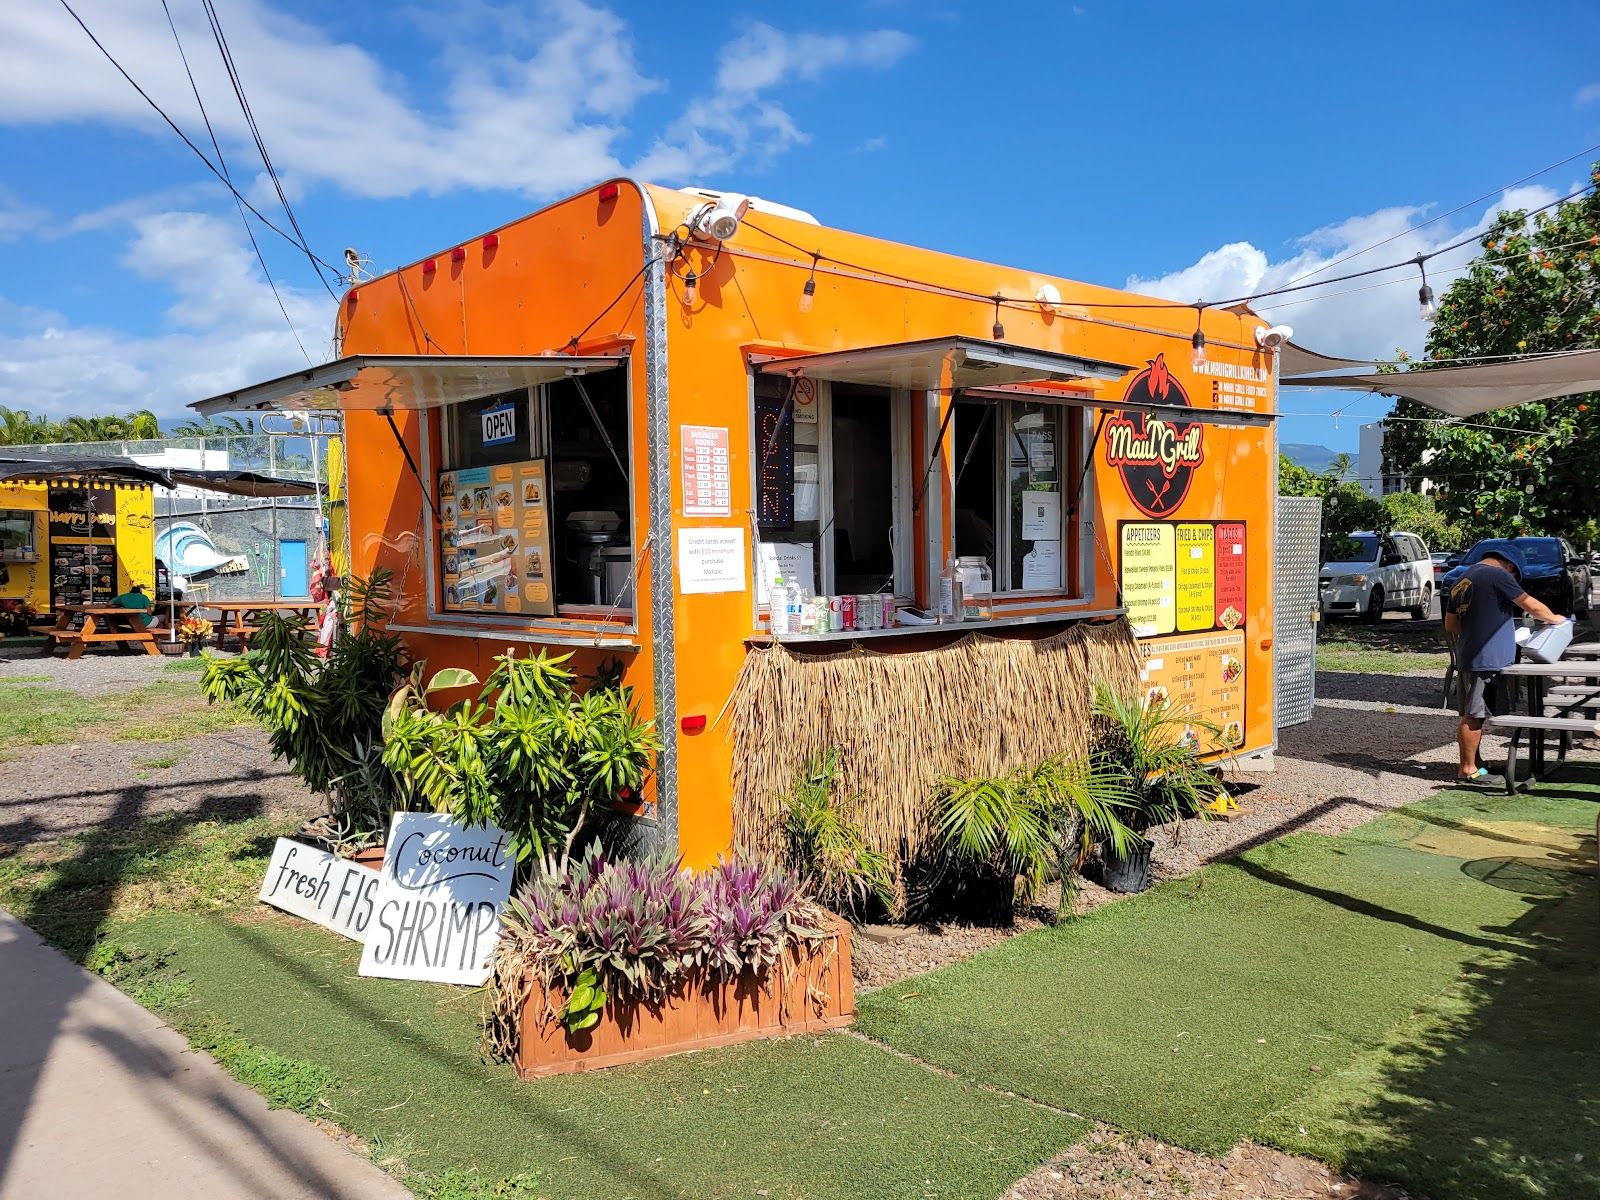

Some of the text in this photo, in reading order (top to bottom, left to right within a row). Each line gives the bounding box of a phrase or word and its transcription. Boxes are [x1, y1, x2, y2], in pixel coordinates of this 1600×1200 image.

[486, 412, 513, 440] OPEN
[1031, 431, 1053, 441] PASS
[1109, 422, 1200, 472] Maui Grill
[50, 511, 116, 526] Happy Belly
[1126, 528, 1161, 541] APPETIZERS
[1177, 528, 1192, 541] FRIED
[1198, 528, 1213, 541] CHIPS
[1222, 527, 1239, 541] TACOS
[1139, 643, 1152, 658] TES
[394, 832, 507, 890] Coconut
[269, 847, 379, 933] fresh FIS
[374, 899, 497, 971] SHRIMP
